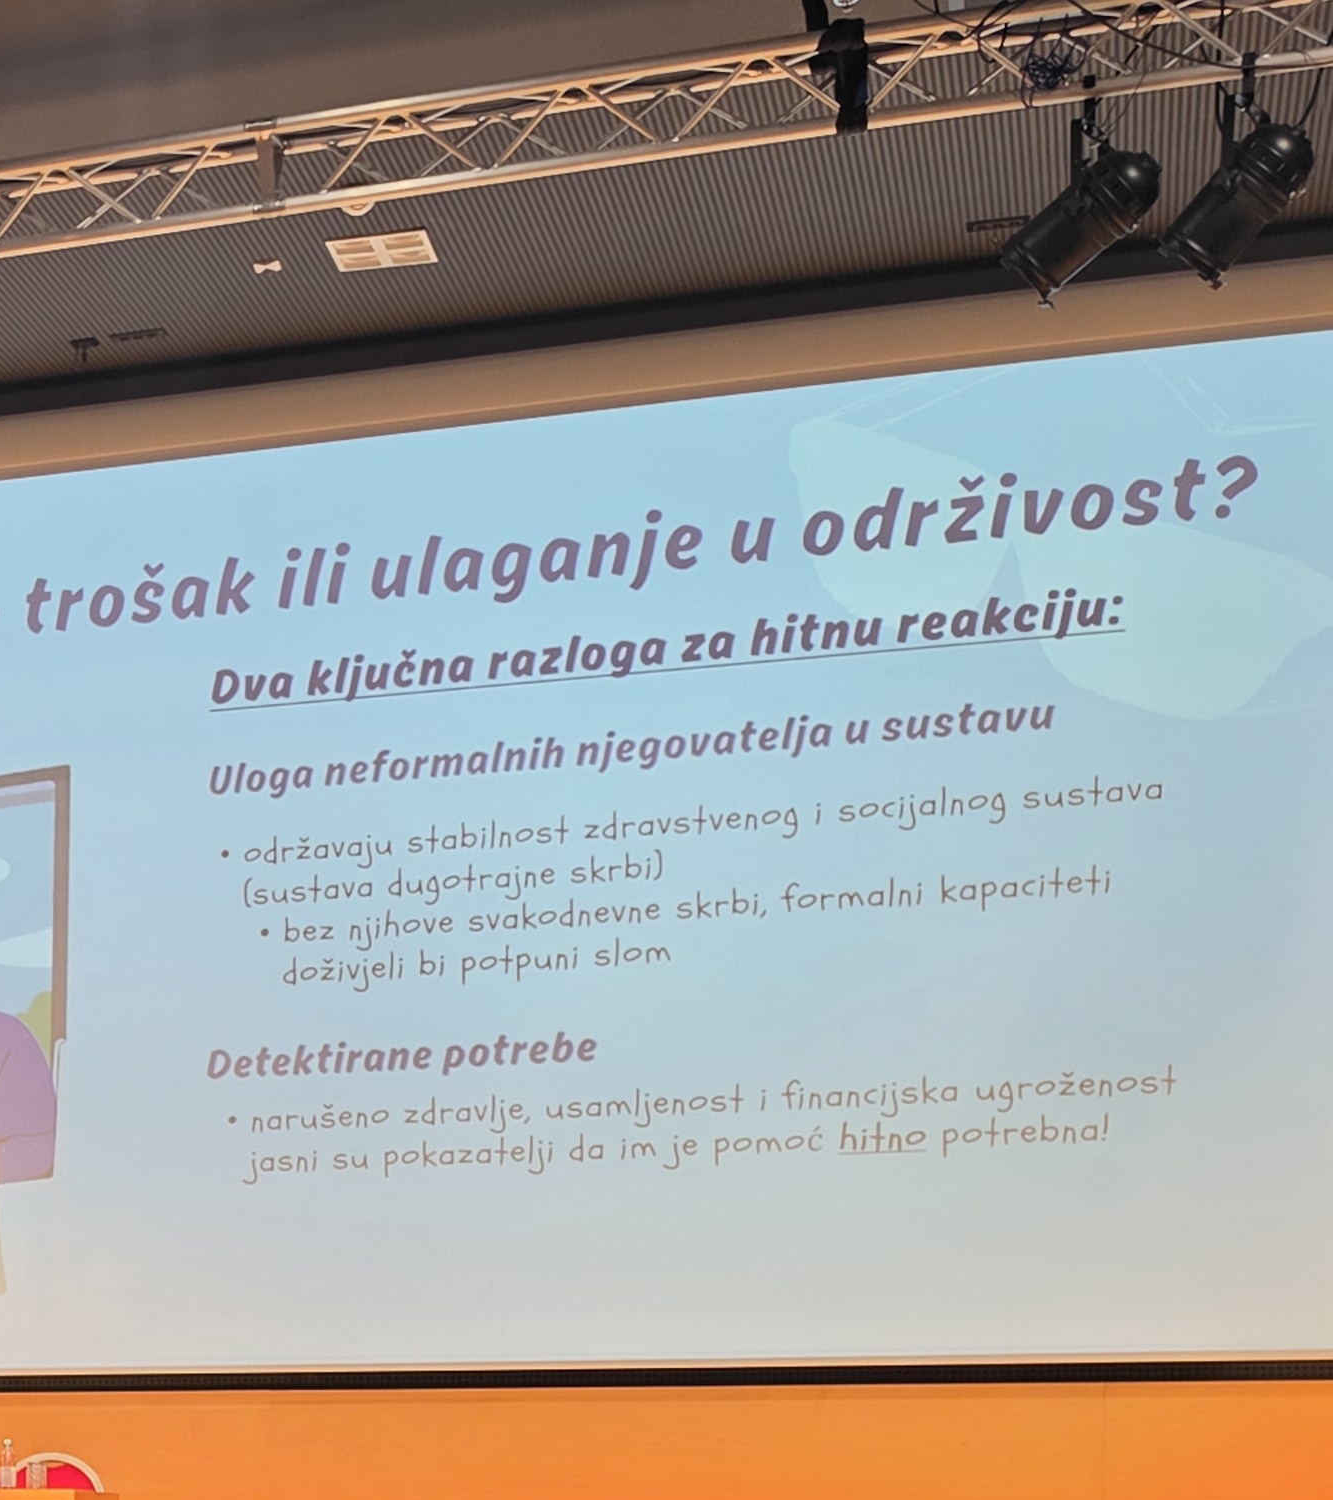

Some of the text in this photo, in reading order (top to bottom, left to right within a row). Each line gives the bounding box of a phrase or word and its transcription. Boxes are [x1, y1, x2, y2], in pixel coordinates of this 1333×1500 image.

[25, 555, 257, 635] trošak
[277, 541, 352, 611] ili
[370, 508, 704, 605] ulaganje
[730, 516, 777, 565] u
[802, 454, 1259, 557] održivost?
[210, 587, 1125, 706] Dva ključna razloga za hitnu reakciju:
[208, 702, 1057, 800] Uloga neformalnih njegovatelja u sustavu
[243, 774, 1163, 870] održavaju stabilnost zdravstvenog i socijalnog sustava
[243, 848, 664, 909] (sustava dugotrajne skrbi)
[283, 863, 1111, 952] bez njihove svakodnevne skrbi, formalni kapaciteti
[282, 936, 672, 993] doživjeli bi potpuni slom
[206, 1030, 599, 1081] Detektirane potrebe
[251, 1063, 1178, 1135] narušeno zdravlje, usamljenost i financijska ugroženost
[241, 1111, 1109, 1186] jasni su pokazatelji da im je pomoć hitno potrebna!
